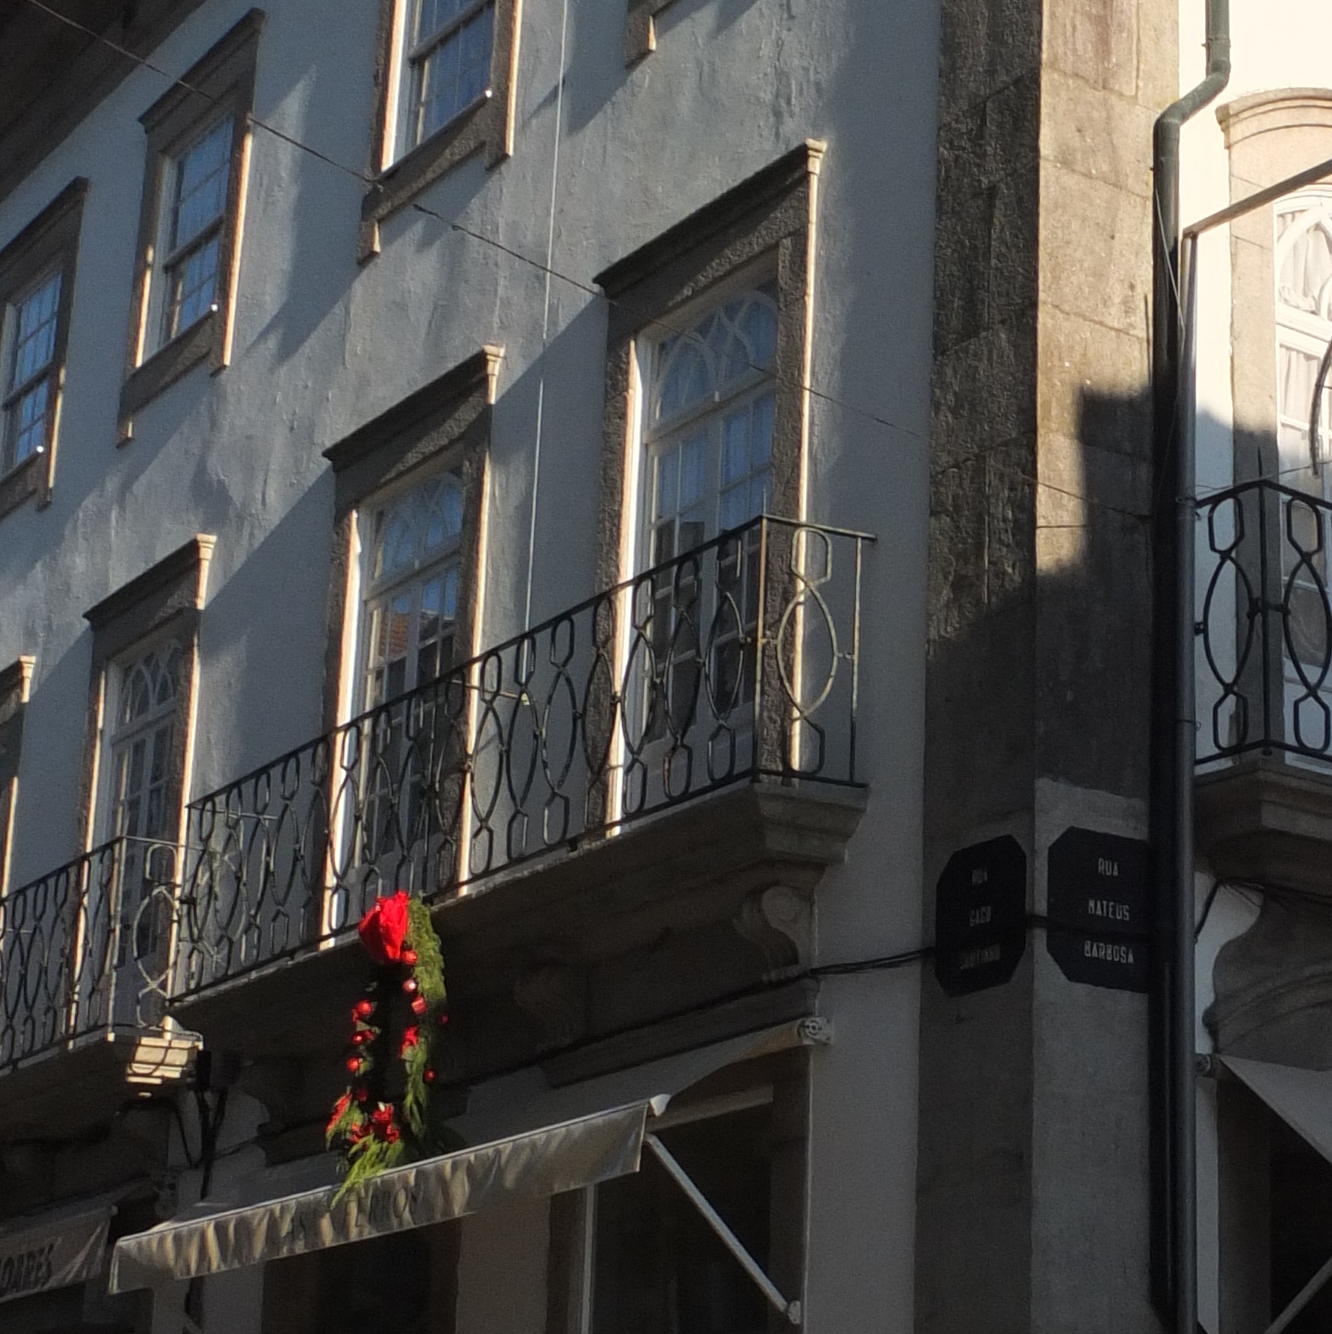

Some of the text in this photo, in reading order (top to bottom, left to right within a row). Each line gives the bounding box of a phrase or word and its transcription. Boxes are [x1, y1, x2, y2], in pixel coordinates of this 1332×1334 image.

[1098, 857, 1119, 877] RUA
[1087, 898, 1131, 922] MATEUS
[1083, 939, 1135, 965] BARBOSA
